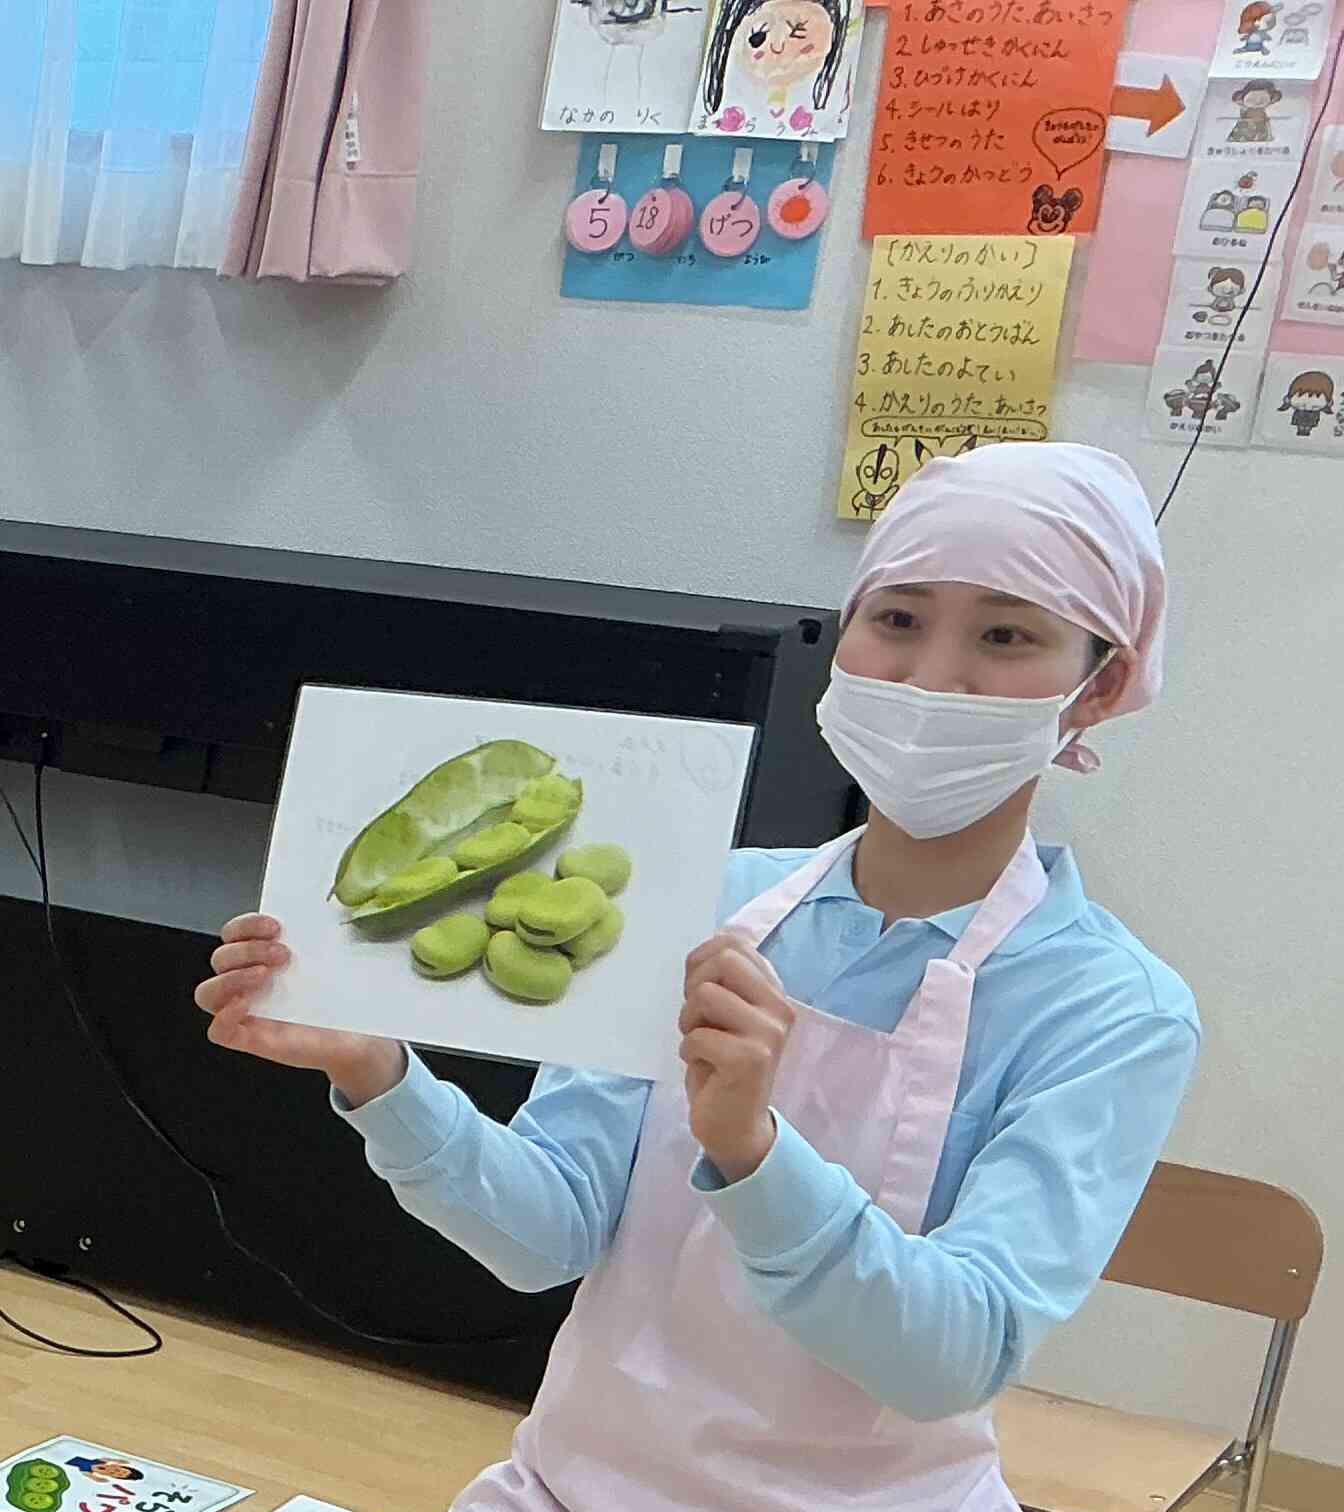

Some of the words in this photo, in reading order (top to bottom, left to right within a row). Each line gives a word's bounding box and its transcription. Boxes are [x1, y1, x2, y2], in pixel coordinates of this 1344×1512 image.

[588, 207, 611, 239] 5
[635, 205, 659, 230] 18
[709, 211, 754, 238] げつ
